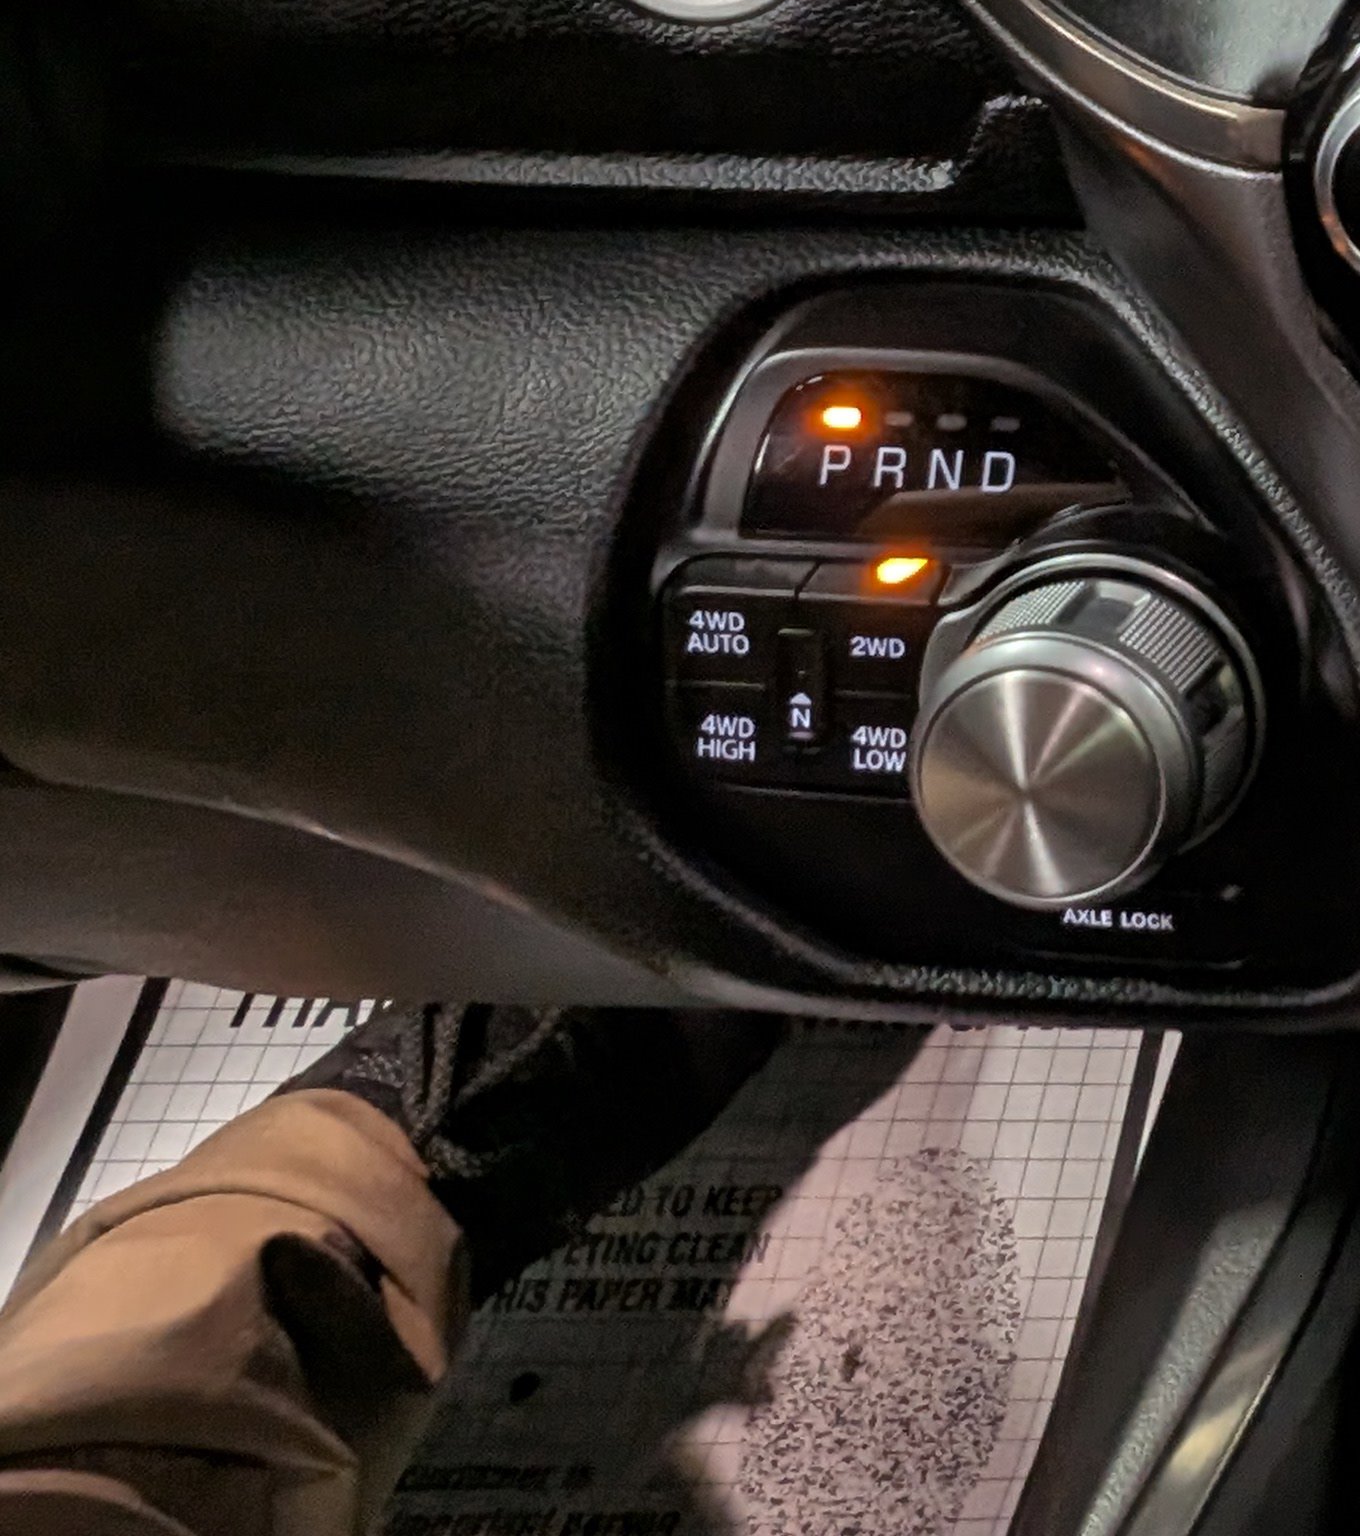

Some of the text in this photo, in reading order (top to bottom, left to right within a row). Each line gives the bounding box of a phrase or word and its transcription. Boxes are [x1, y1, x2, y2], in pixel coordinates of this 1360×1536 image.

[819, 444, 1017, 494] P R N D
[689, 610, 745, 632] 4WD
[687, 632, 750, 655] AUTO
[850, 636, 906, 658] 2WD
[701, 714, 755, 738] 4WD
[791, 707, 811, 728] N
[852, 725, 907, 749] 4WD
[697, 737, 756, 762] HIGH
[853, 749, 907, 772] LOW
[1063, 907, 1174, 931] AXLE LOCK
[702, 1184, 784, 1218] KEEP
[667, 1232, 774, 1265] CLEAN
[554, 1277, 664, 1312] PAPER
